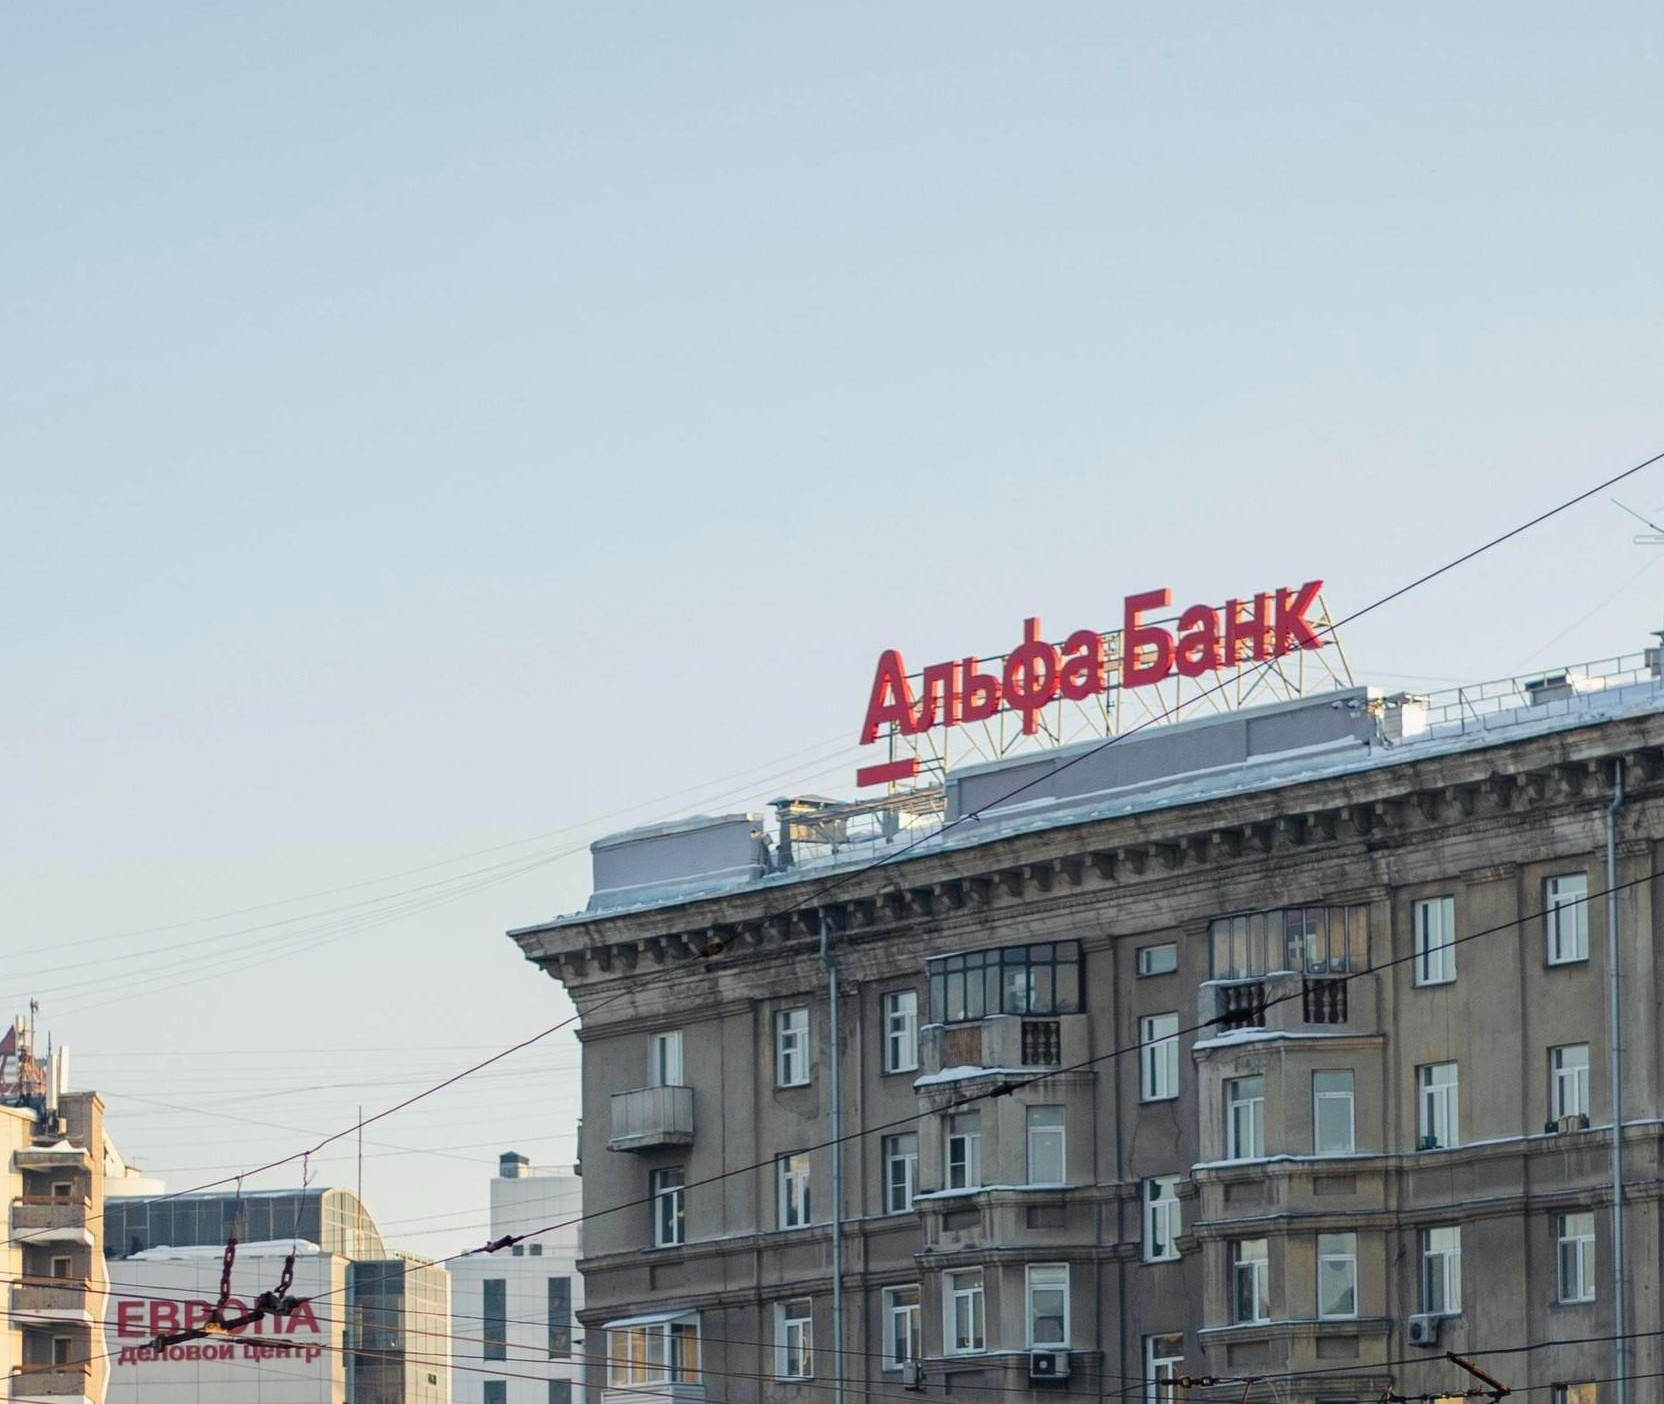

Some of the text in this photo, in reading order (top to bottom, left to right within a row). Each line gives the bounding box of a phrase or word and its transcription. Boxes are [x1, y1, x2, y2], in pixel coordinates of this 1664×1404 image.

[859, 579, 1325, 746] Альфа Банк
[117, 1296, 322, 1339] ЕВРОПА
[118, 1342, 322, 1366] деловой центр
